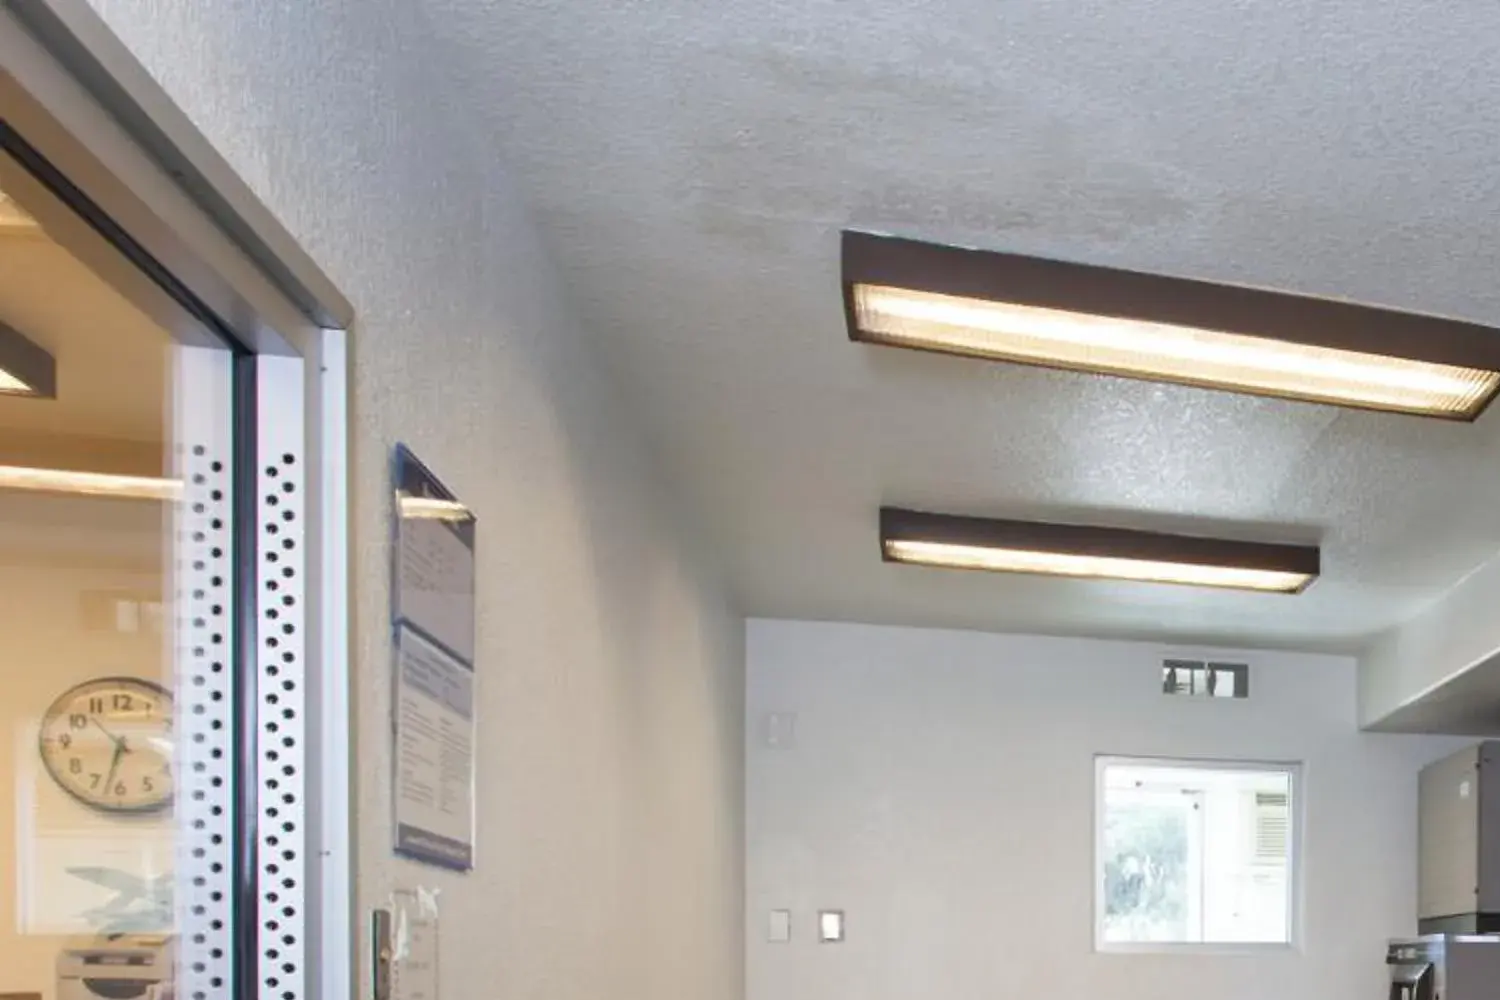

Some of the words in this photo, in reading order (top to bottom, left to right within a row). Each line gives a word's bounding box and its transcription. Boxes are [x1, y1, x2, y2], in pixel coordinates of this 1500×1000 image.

[89, 698, 103, 714] 11
[113, 694, 133, 711] 12
[69, 713, 87, 729] 10
[58, 733, 72, 749] 9
[69, 758, 82, 774] 8
[89, 773, 102, 790] 7
[114, 781, 127, 796] 6
[142, 776, 154, 792] 5
